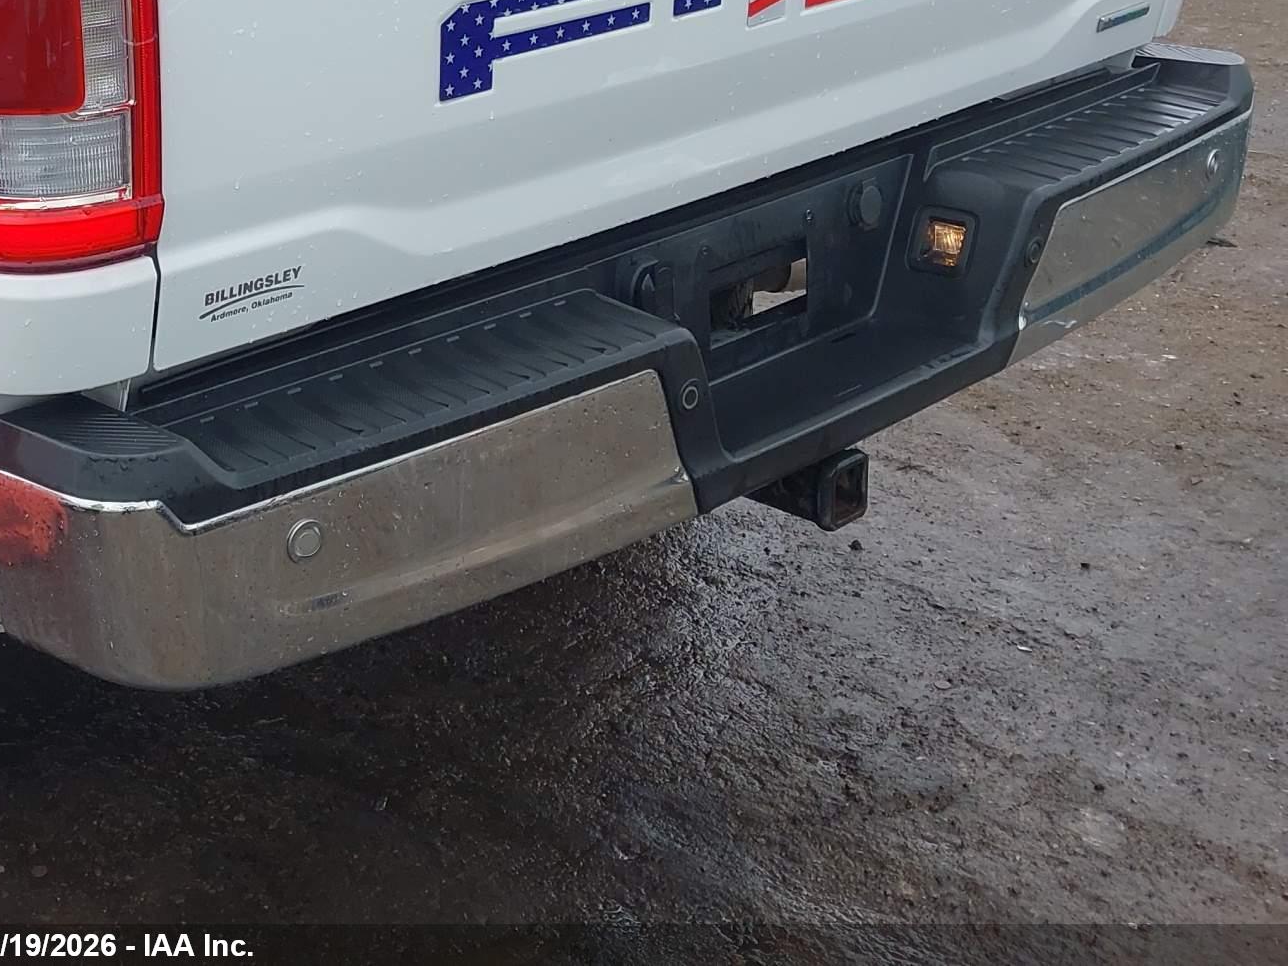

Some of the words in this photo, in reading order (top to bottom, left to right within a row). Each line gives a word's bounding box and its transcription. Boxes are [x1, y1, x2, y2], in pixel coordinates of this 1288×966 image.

[204, 265, 302, 307] BILLINGSLEY
[210, 306, 249, 322] Ardmore,
[251, 292, 293, 309] Oklahoma
